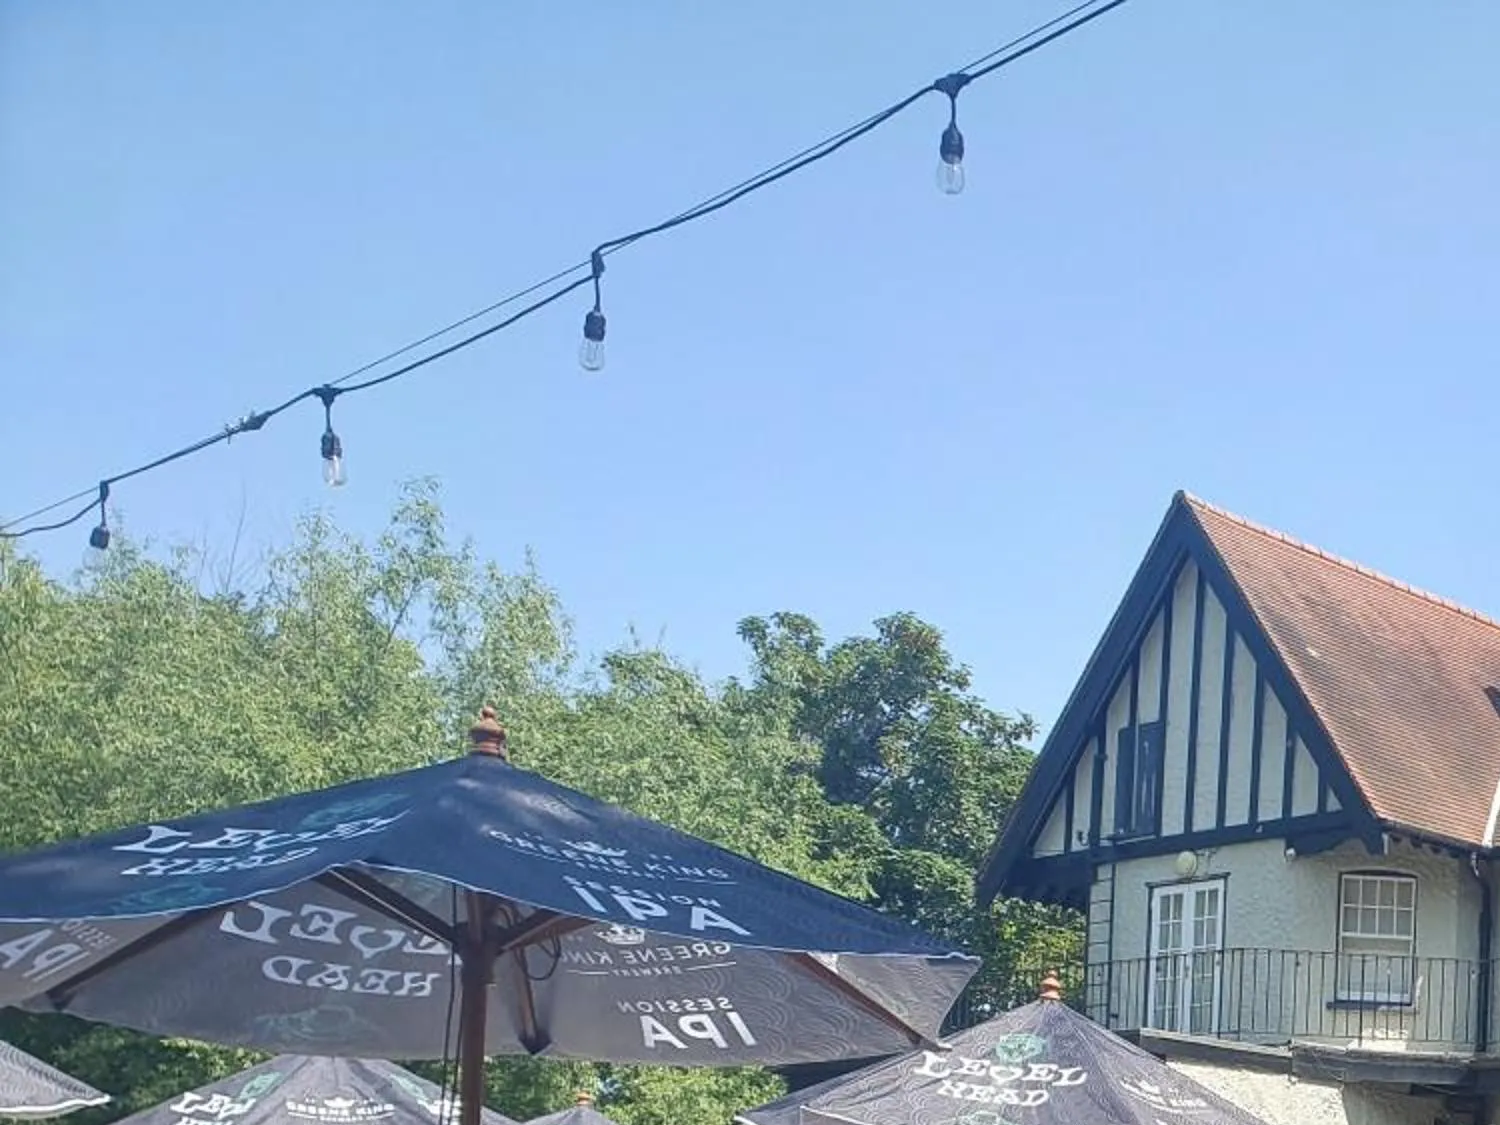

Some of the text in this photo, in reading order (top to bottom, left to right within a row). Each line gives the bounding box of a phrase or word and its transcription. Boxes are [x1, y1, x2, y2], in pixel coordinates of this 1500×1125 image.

[644, 862, 730, 879] KING
[573, 886, 752, 936] IPA
[913, 1050, 1088, 1087] LEVEL
[937, 1079, 1050, 1107] HEAD
